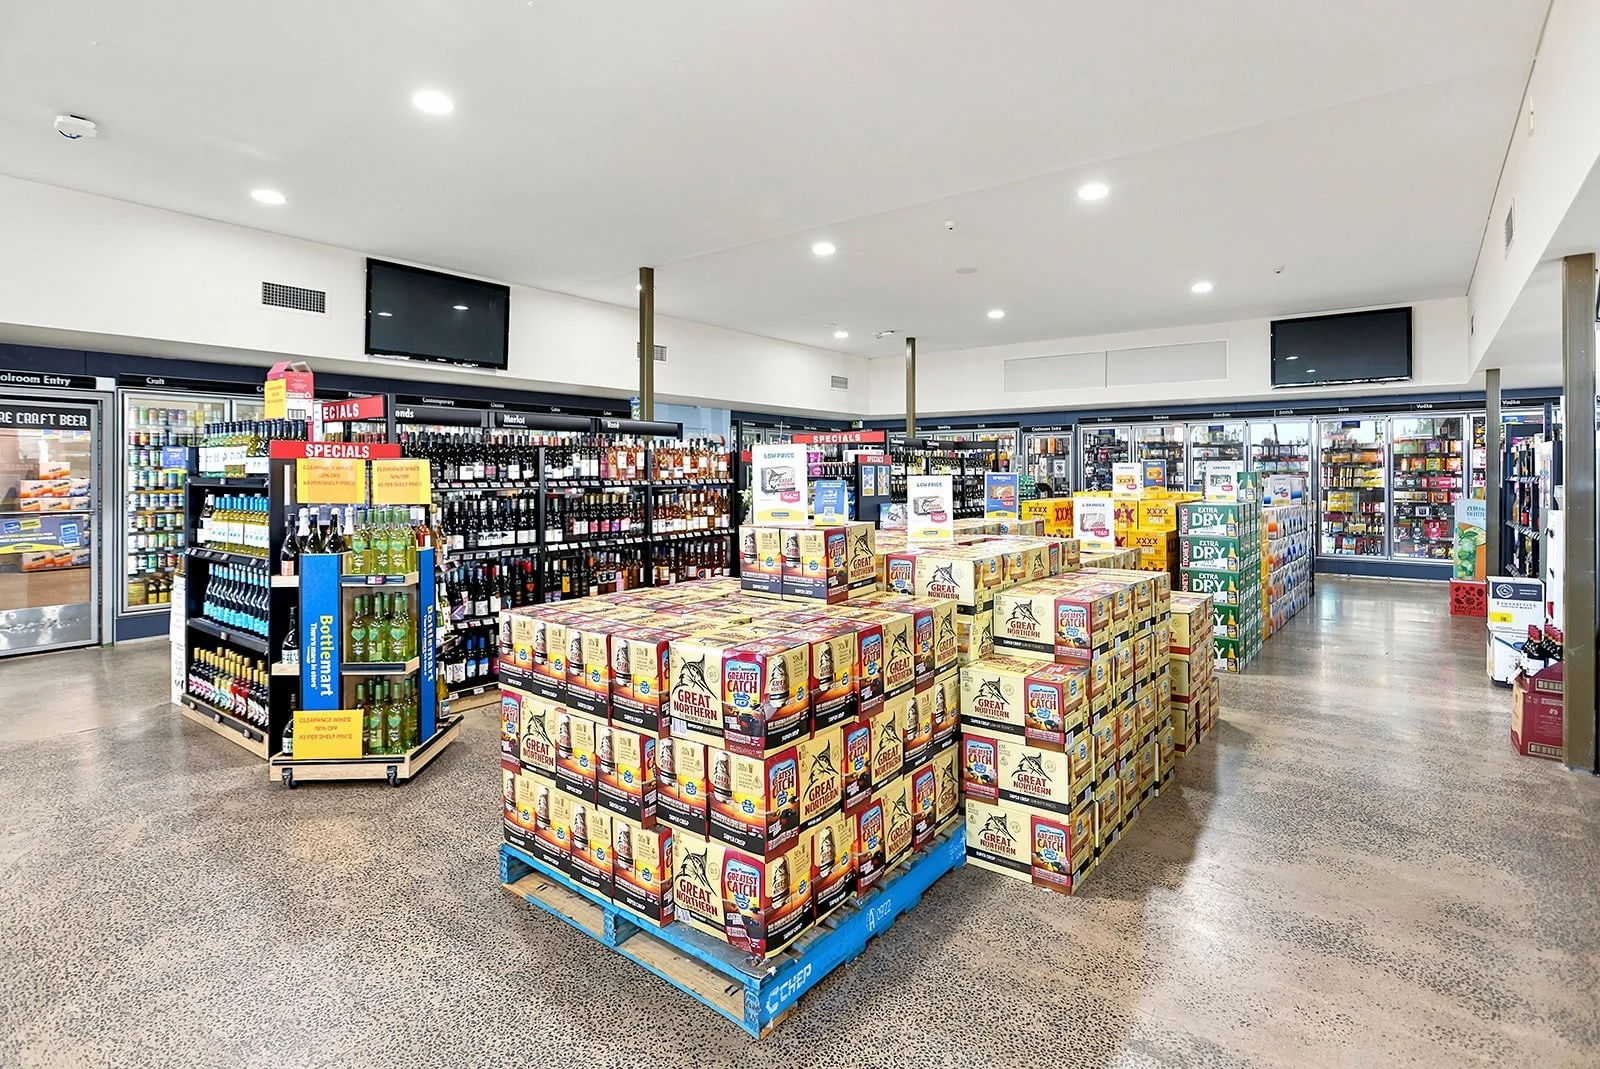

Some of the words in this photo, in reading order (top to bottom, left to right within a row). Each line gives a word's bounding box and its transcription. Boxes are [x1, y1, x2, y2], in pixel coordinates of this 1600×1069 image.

[43, 375, 71, 386] Entry
[16, 412, 56, 425] CRAFT
[59, 414, 88, 426] BEER
[504, 414, 525, 424] Merlot
[813, 434, 861, 444] SPECIALS
[306, 444, 370, 458] SPECIALS
[1192, 512, 1224, 526] DRY
[1193, 547, 1225, 559] DRY
[854, 556, 871, 570] GREAT
[931, 584, 956, 594] GREAT
[1192, 580, 1225, 592] DRY
[928, 591, 959, 600] NORTHERN
[1010, 620, 1036, 632] GREAT
[1060, 618, 1085, 628] CATCH
[1007, 627, 1040, 638] NORTHERN
[940, 637, 954, 650] GREAT
[319, 615, 334, 696] Bottlemart
[890, 657, 910, 674] GREAT
[728, 672, 758, 681] GREATEST
[727, 680, 757, 694] CATCH
[678, 690, 710, 708] GREAT
[978, 698, 1005, 710] GREAT
[1030, 699, 1056, 710] CATCH
[674, 701, 718, 720] NORTHERN
[974, 706, 1009, 718] NORTHERN
[526, 738, 549, 754] GREAT
[523, 747, 554, 767] NORTHERN
[878, 746, 899, 766] GREAT
[968, 753, 992, 765] CATCH
[875, 756, 902, 778] NORTHERN
[1018, 773, 1047, 786] GREAT
[809, 776, 834, 801] GREAT
[1014, 781, 1051, 796] NORTHERN
[804, 787, 839, 816] NORTHERN
[891, 820, 911, 841] GREAT
[1037, 832, 1064, 842] GREATEST
[984, 832, 1012, 846] GREAT
[1038, 840, 1063, 852] CATCH
[980, 840, 1016, 856] NORTHERN
[728, 872, 757, 885] GREATEST
[680, 879, 711, 904] GREAT
[726, 881, 757, 898] CATCH
[676, 890, 718, 916] NORTHERN
[780, 963, 812, 1001] CHEP
